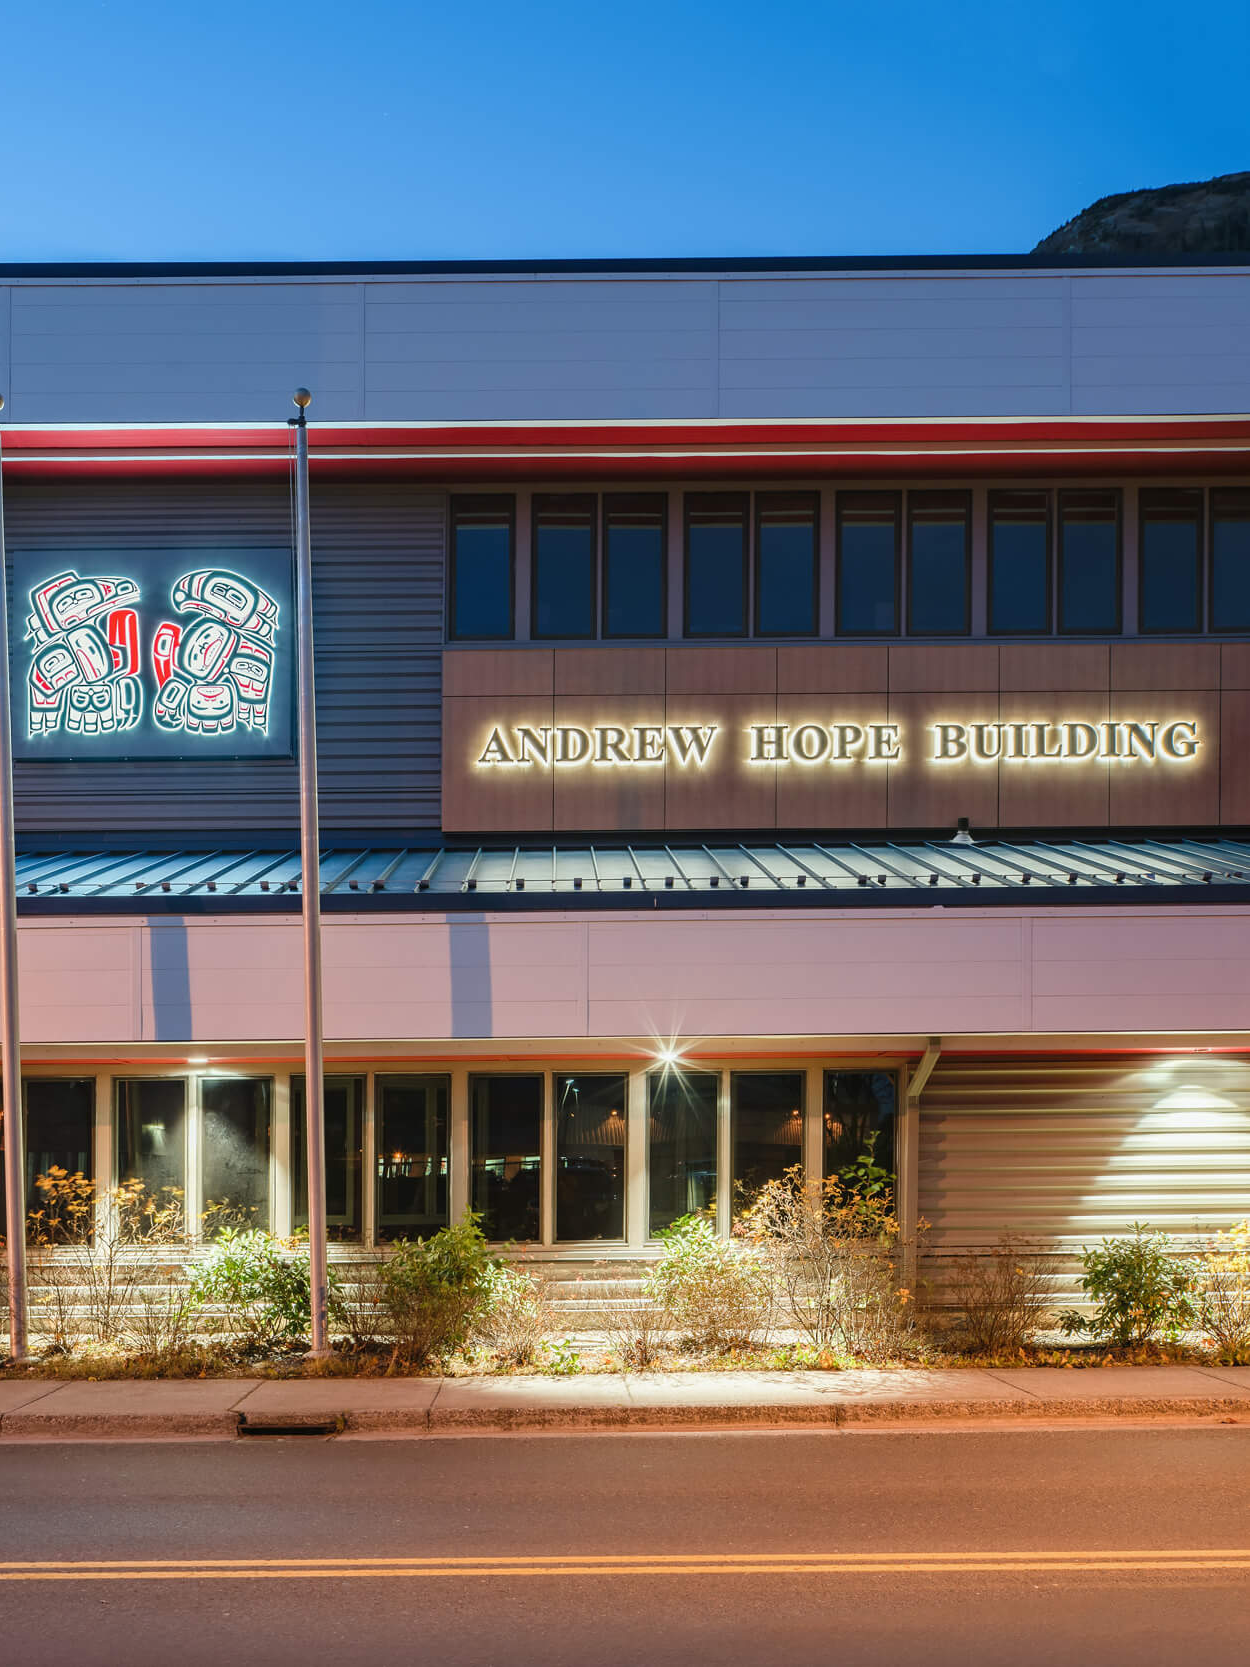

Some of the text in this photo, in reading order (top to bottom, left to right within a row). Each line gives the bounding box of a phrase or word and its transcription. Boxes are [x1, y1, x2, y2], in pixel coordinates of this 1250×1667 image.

[477, 721, 1201, 765] ANDREW HOPE BUILDING
